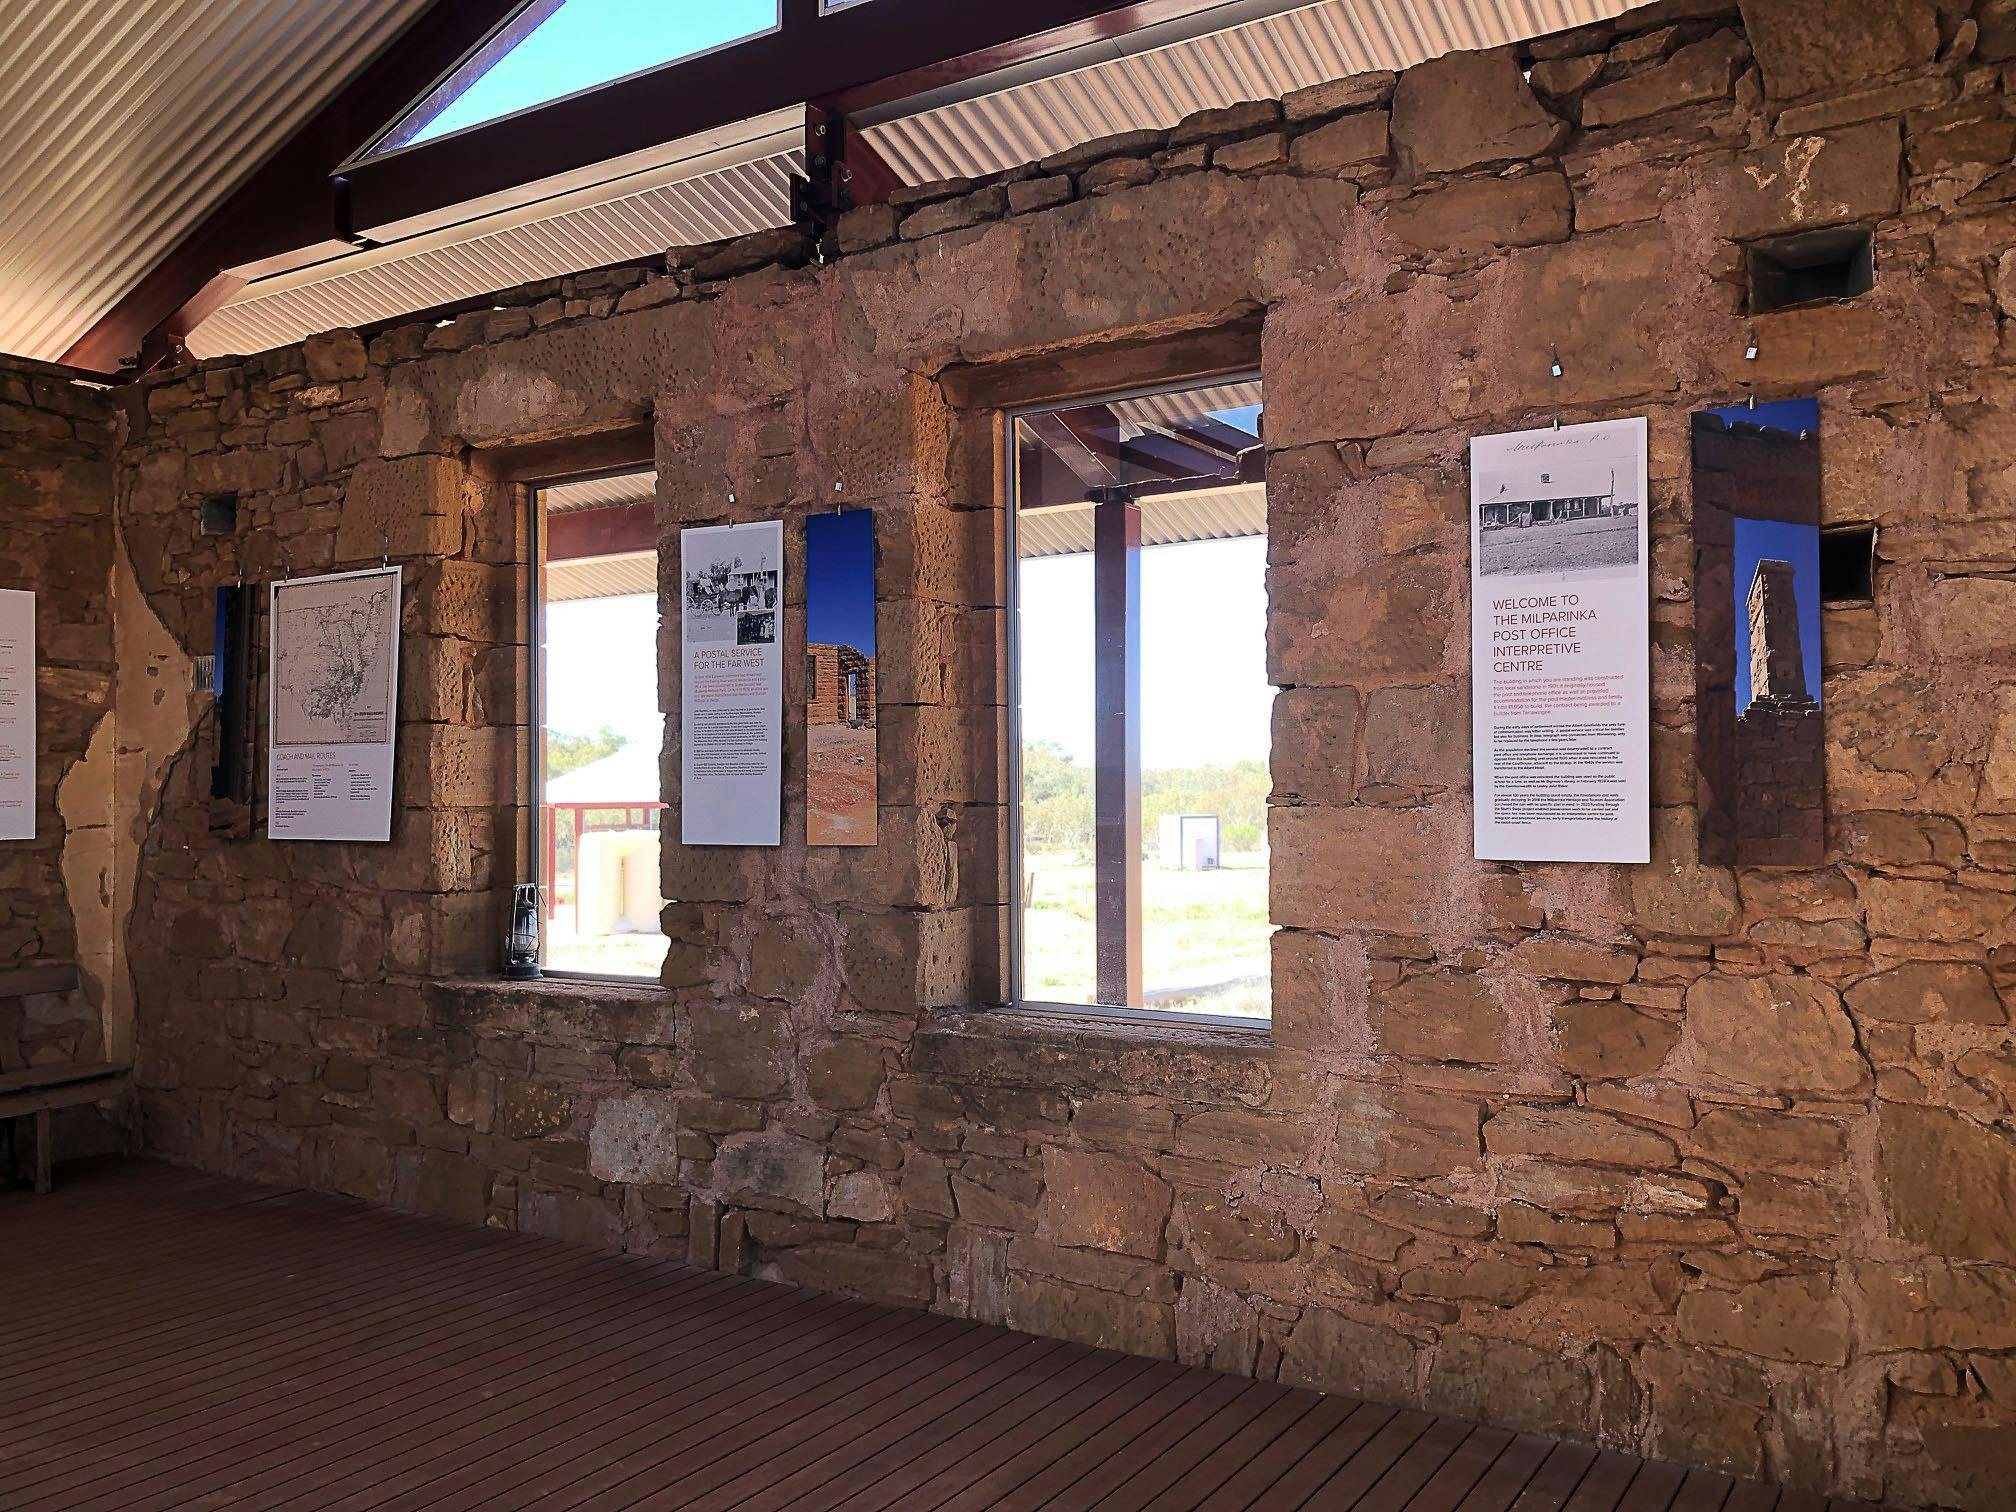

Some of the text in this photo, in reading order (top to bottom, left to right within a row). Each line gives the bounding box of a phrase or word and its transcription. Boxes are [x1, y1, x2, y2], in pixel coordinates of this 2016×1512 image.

[1493, 594, 1579, 610] WELCOME TO
[1494, 610, 1597, 626] THE MILPARINKA
[1494, 627, 1576, 641] POST OFFICE
[702, 650, 729, 658] POSTAL
[731, 648, 762, 658] SERVICE
[1494, 642, 1581, 658] INTERPRETIVE
[694, 658, 764, 670] FOR THE FAR WEST
[1494, 660, 1543, 673] CENTRE
